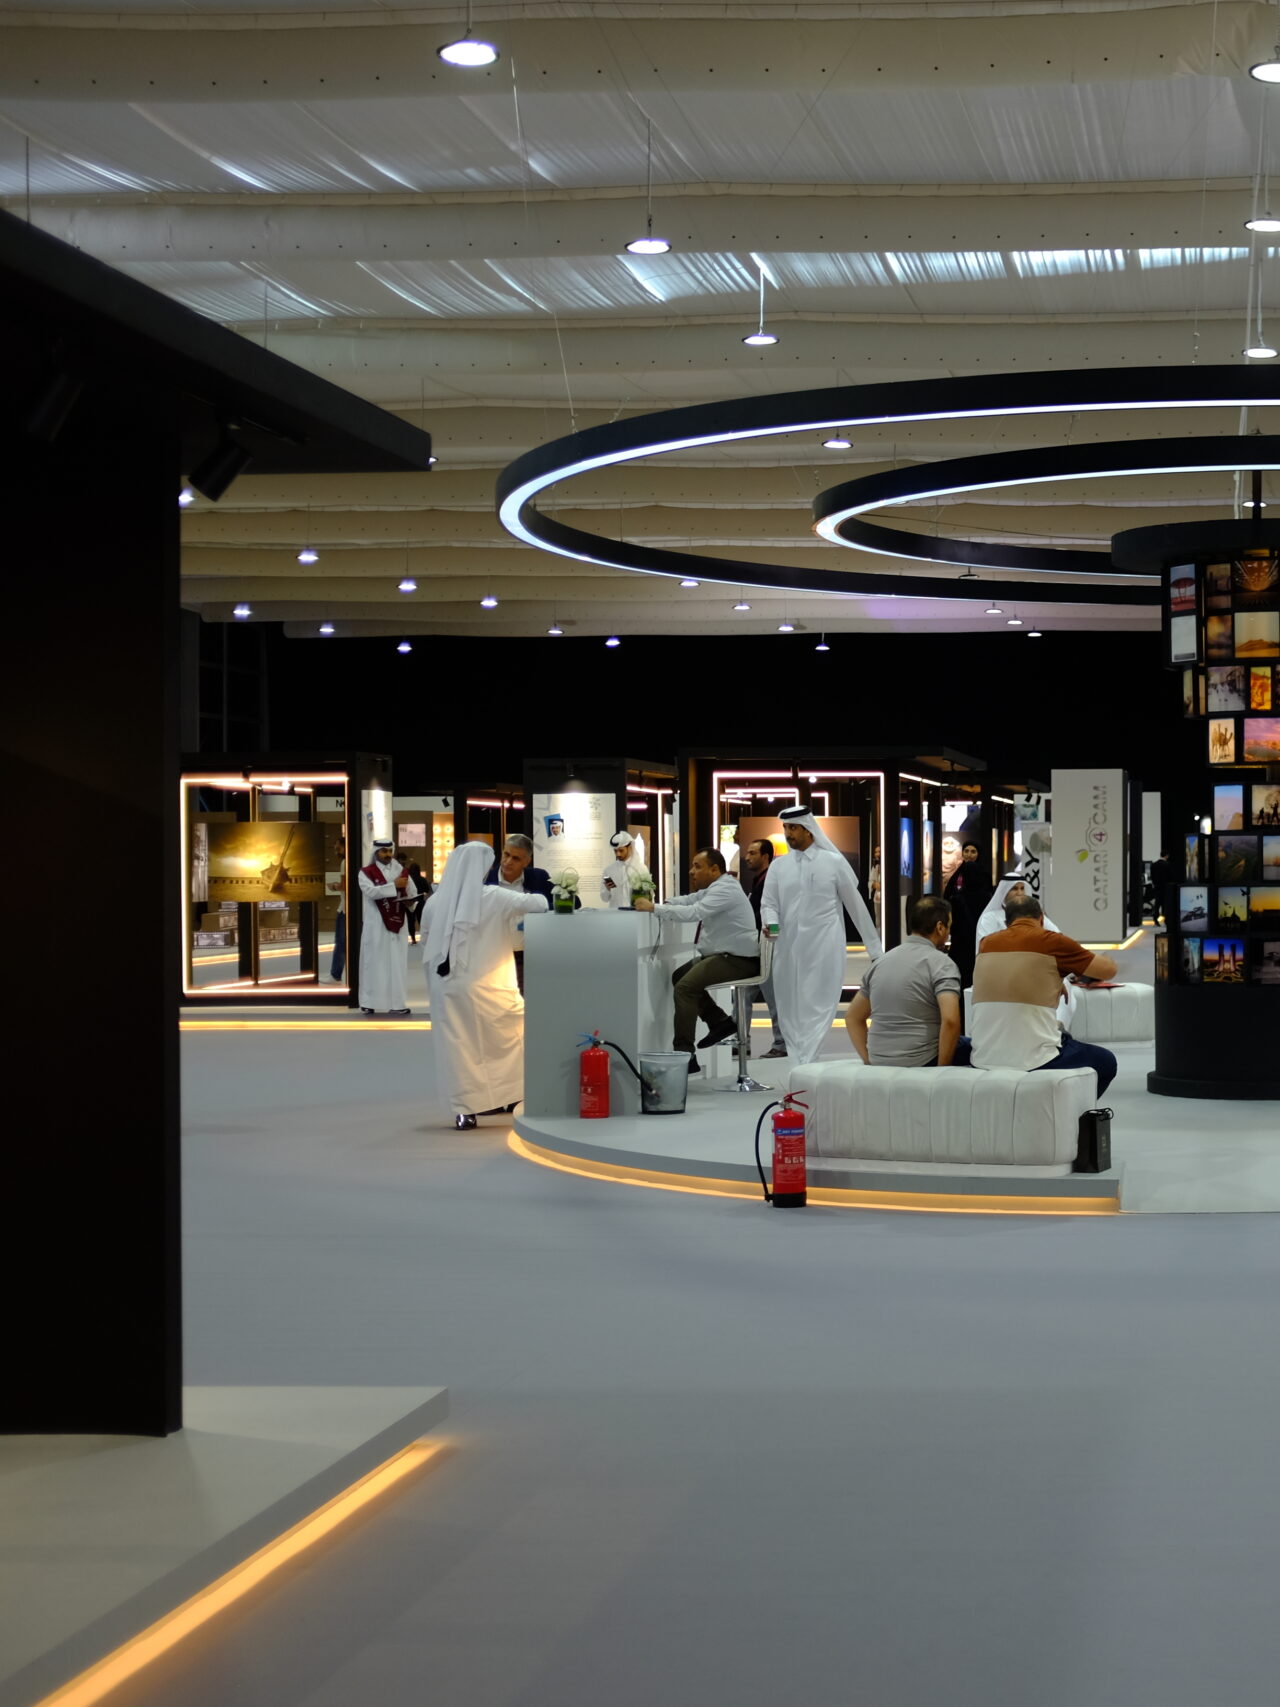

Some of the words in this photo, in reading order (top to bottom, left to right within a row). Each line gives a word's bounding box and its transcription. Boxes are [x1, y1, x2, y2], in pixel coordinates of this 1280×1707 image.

[1092, 785, 1108, 825] CAM
[1093, 831, 1106, 843] 4
[1093, 854, 1108, 912] QATAR
